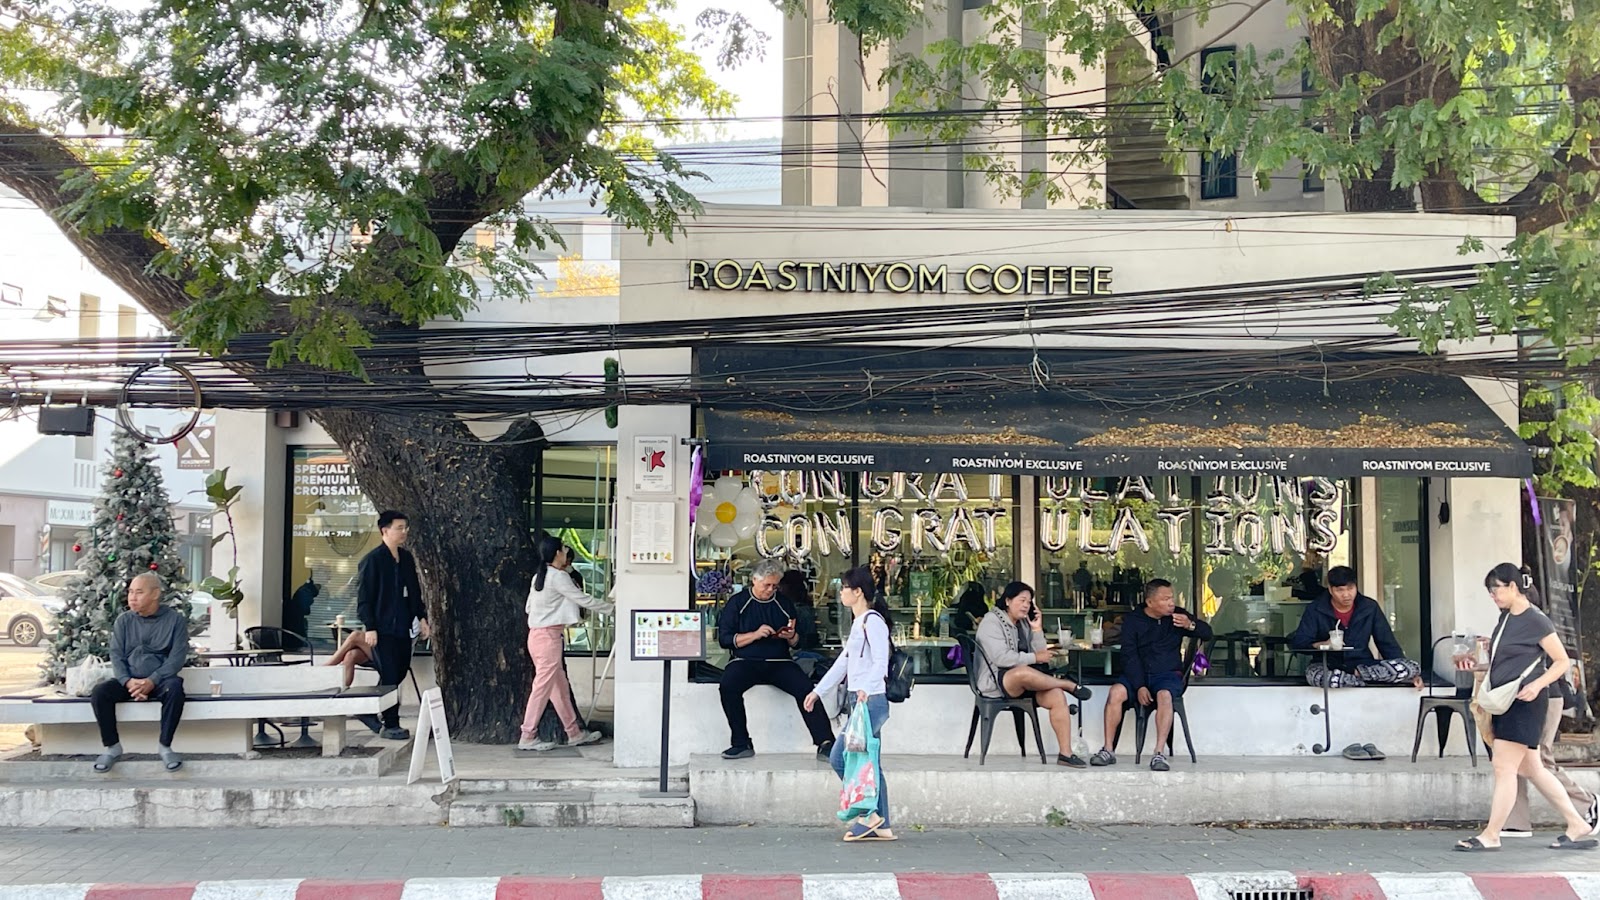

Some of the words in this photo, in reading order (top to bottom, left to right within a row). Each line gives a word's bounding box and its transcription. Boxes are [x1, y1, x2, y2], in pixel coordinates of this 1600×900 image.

[689, 259, 948, 294] ROASTNIYOM
[965, 263, 1113, 295] COFFEE
[743, 453, 815, 464] ROASTNIYOM
[817, 454, 875, 465] EXCLUSIVE
[952, 457, 1023, 468] ROASTNIYOM
[1025, 459, 1083, 470] EXCLUSIVE
[1158, 460, 1229, 471] ROASTNIYOM
[1230, 460, 1288, 471] EXCLUSIVE
[1362, 460, 1433, 471] ROASTNIYOM
[1434, 461, 1492, 472] EXCLUSIVE
[294, 475, 350, 485] PREMIUM
